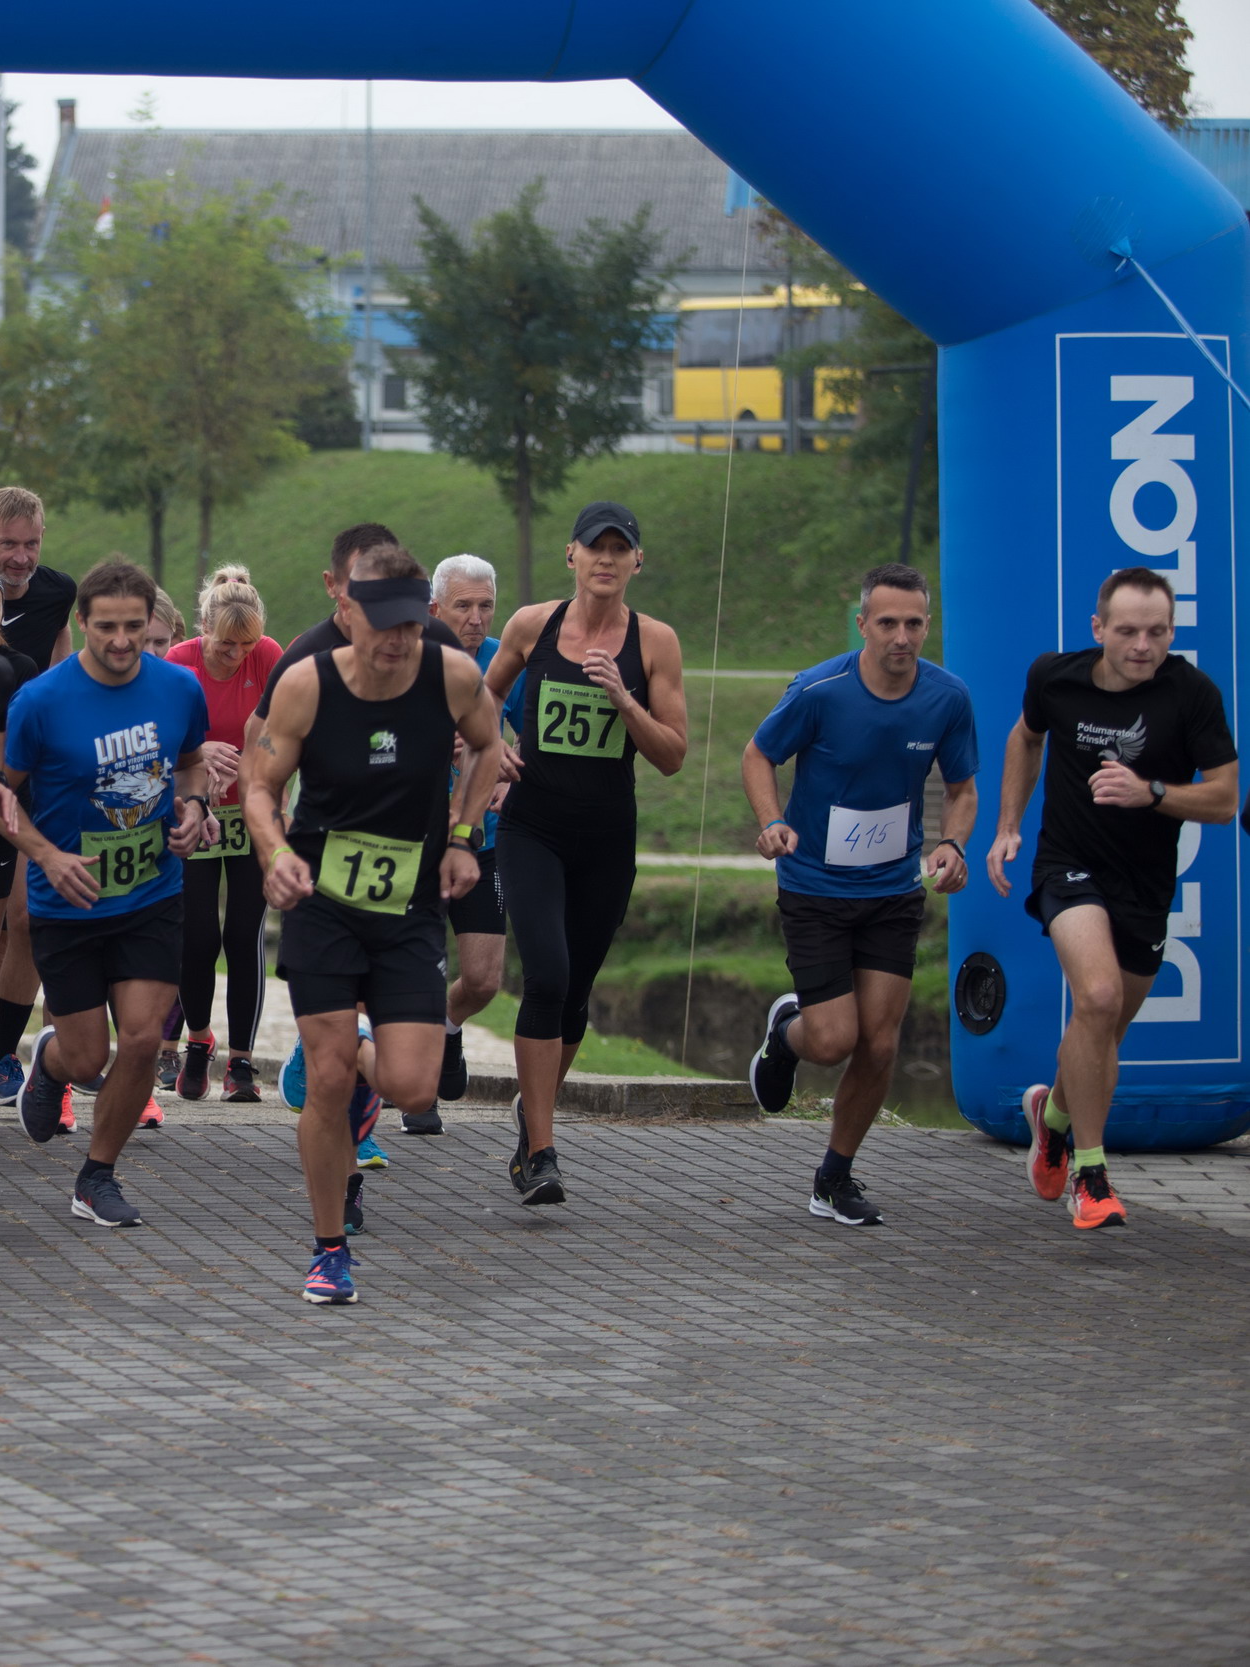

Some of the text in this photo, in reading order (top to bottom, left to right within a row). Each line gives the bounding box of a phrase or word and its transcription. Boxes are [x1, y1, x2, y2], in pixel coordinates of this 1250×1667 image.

[94, 721, 161, 766] LITICE
[542, 700, 619, 749] 257
[1077, 722, 1137, 738] Polumaraton
[844, 821, 896, 852] 415
[99, 837, 156, 889] 185
[343, 850, 397, 902] 13
